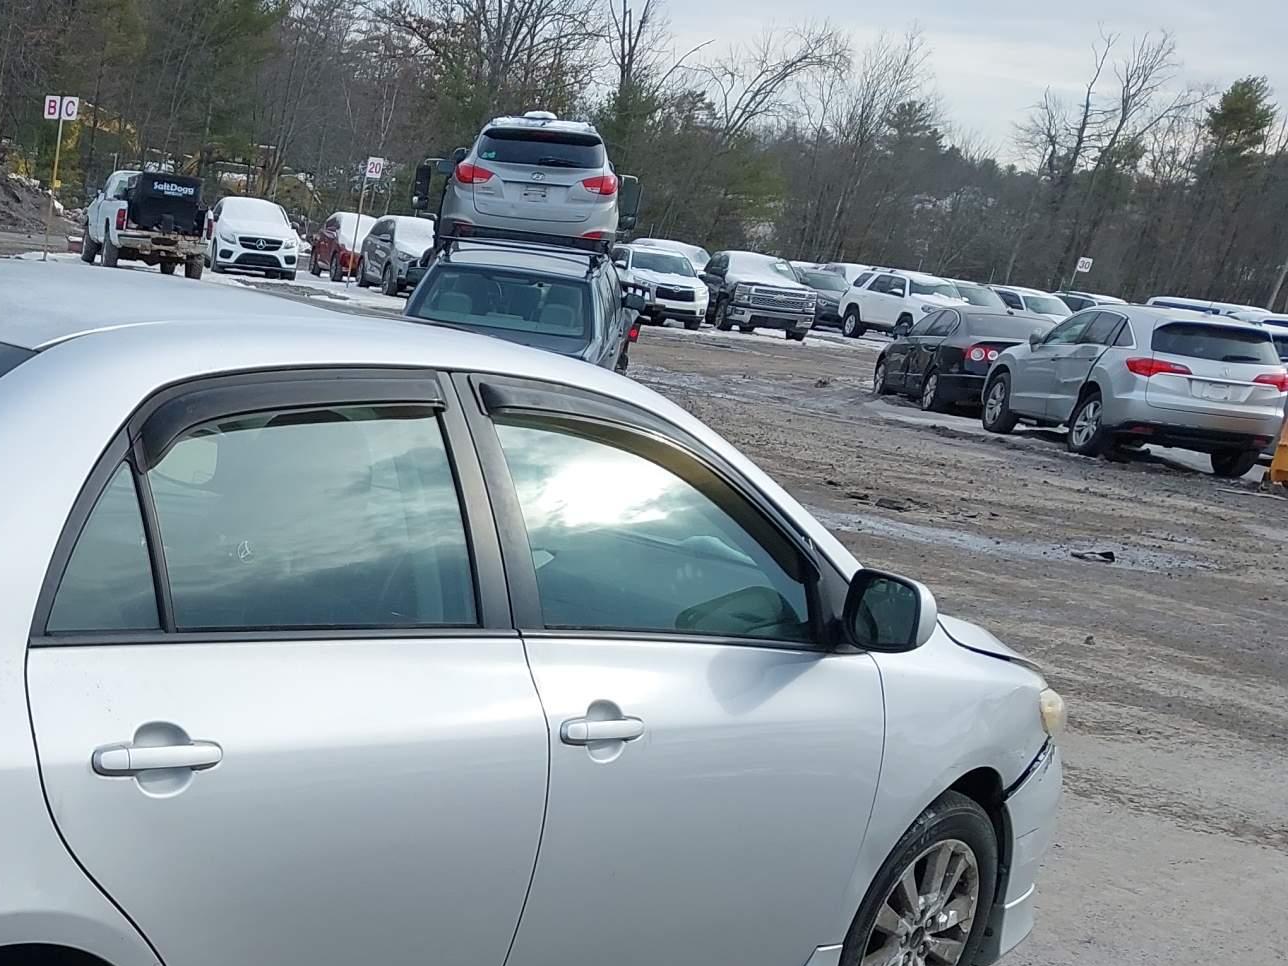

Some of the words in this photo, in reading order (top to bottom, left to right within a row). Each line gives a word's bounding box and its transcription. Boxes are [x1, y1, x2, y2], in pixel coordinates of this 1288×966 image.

[48, 100, 57, 115] B
[65, 101, 75, 116] C
[368, 162, 381, 174] 20
[153, 181, 194, 195] SaltDogg
[1079, 260, 1090, 269] 30
